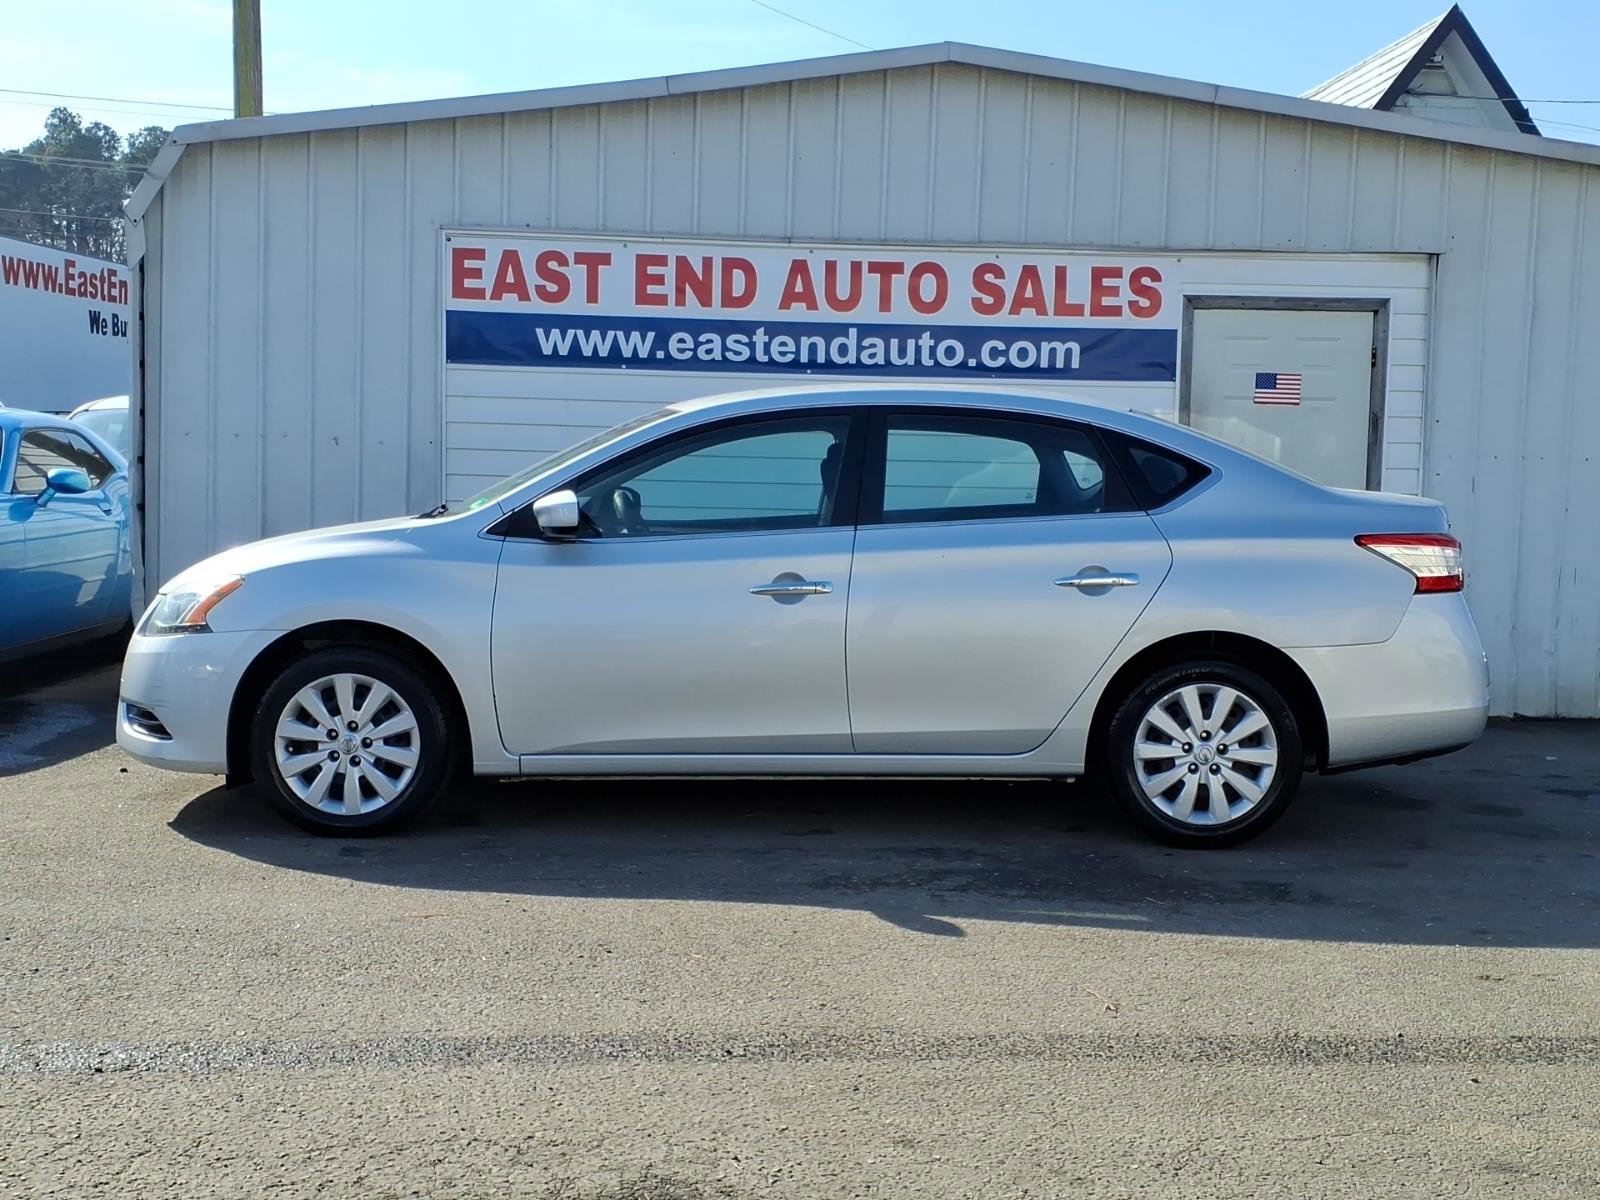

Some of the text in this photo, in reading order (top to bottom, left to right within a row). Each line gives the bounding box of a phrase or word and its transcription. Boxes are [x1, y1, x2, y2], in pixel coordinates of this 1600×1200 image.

[451, 247, 1163, 319] EAST END AUTO SALES
[88, 309, 128, 344] We Bu
[535, 327, 1080, 369] www.eastendauto.com
